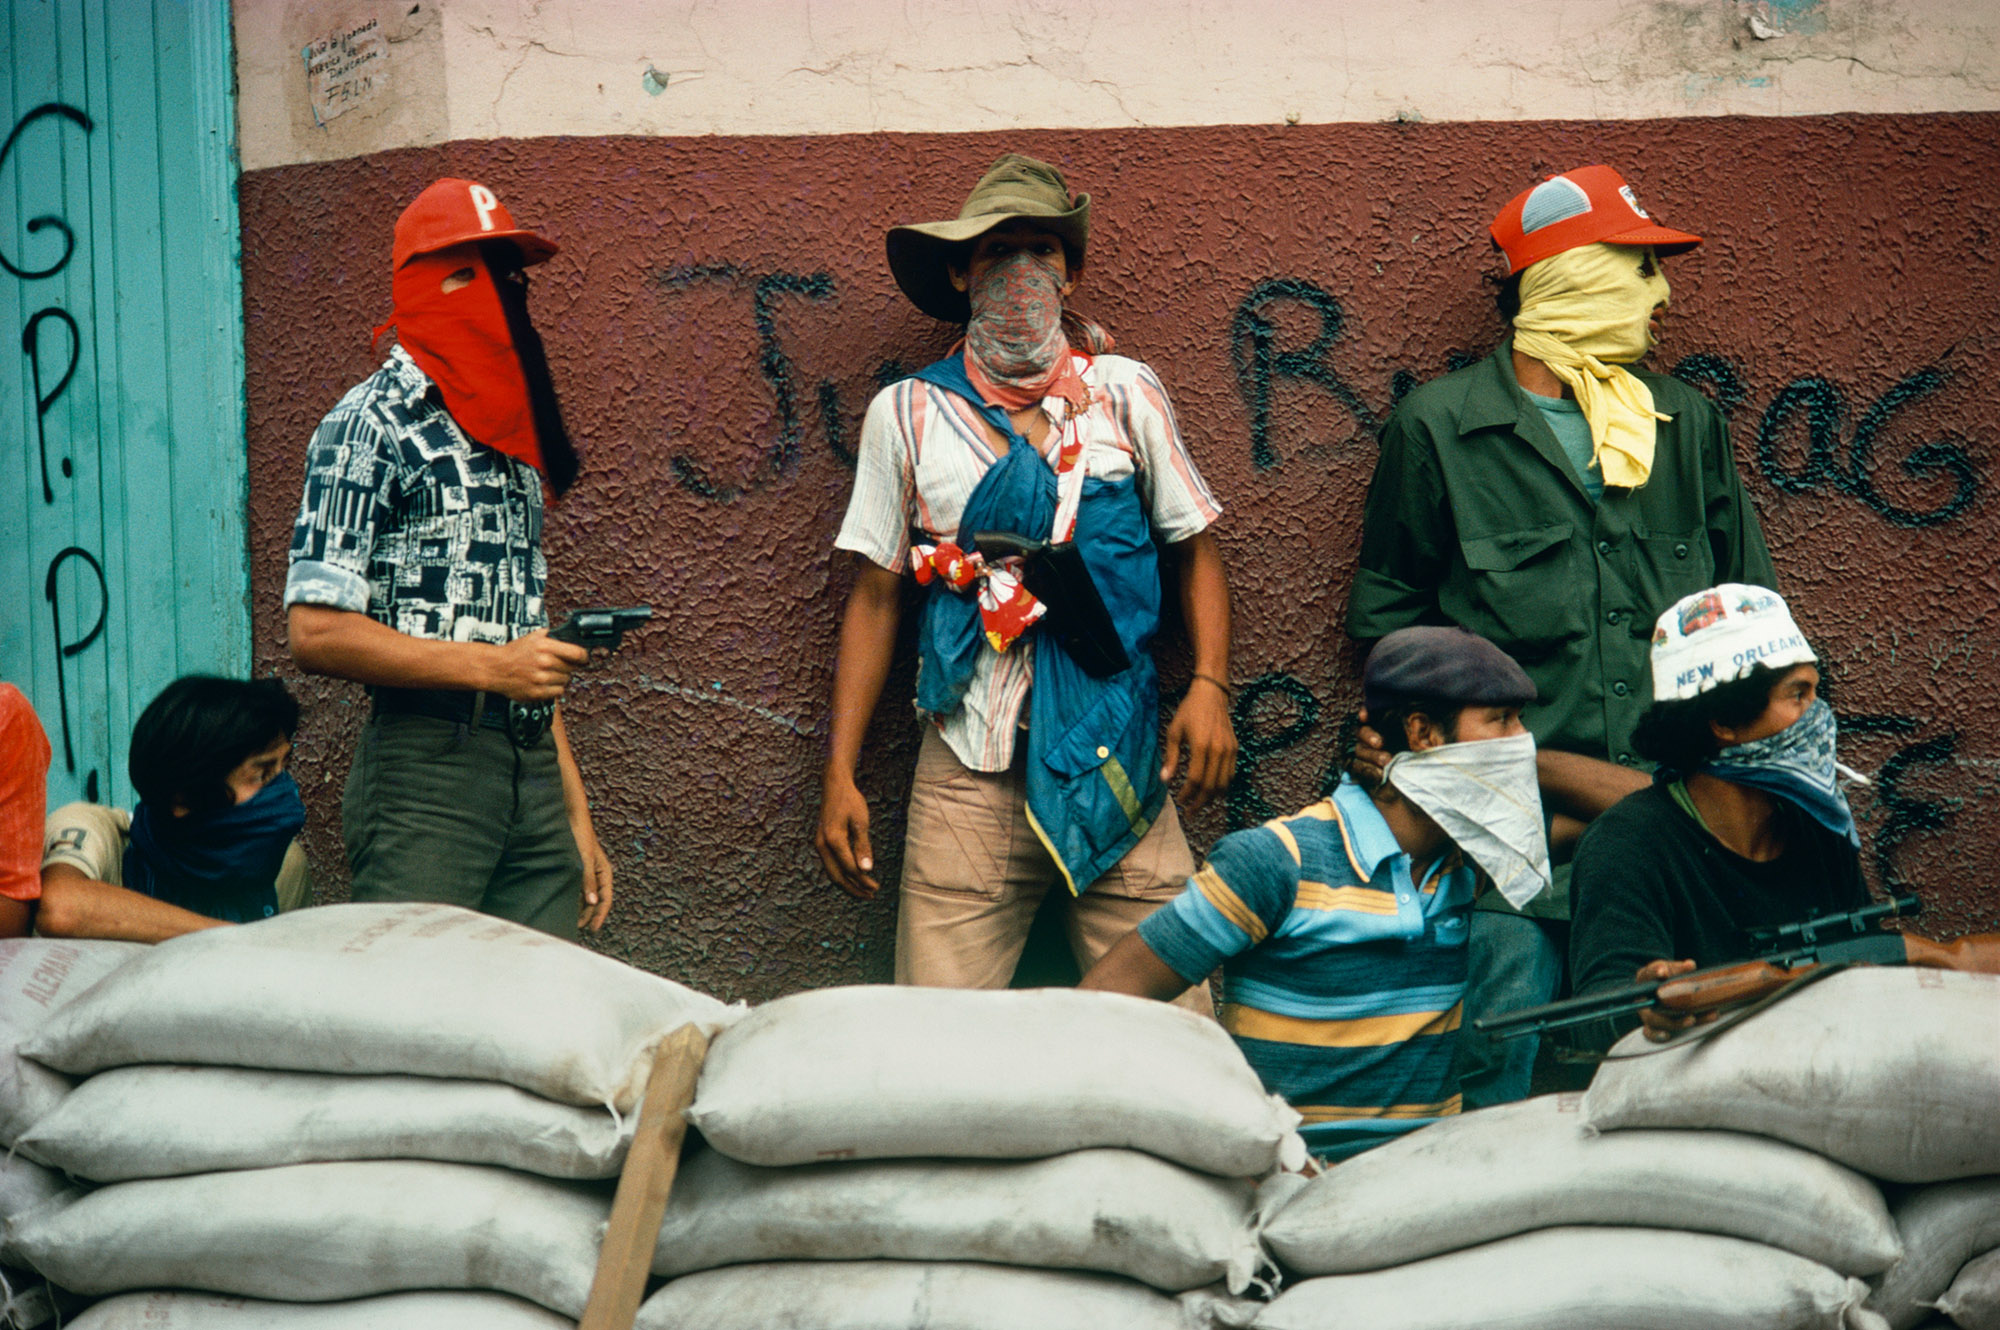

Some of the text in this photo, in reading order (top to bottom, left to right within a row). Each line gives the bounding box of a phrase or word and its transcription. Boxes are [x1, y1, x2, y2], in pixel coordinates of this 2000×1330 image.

[324, 76, 373, 106] FSLN
[468, 184, 498, 231] P
[1676, 634, 1804, 689] NEW ORLEANS
